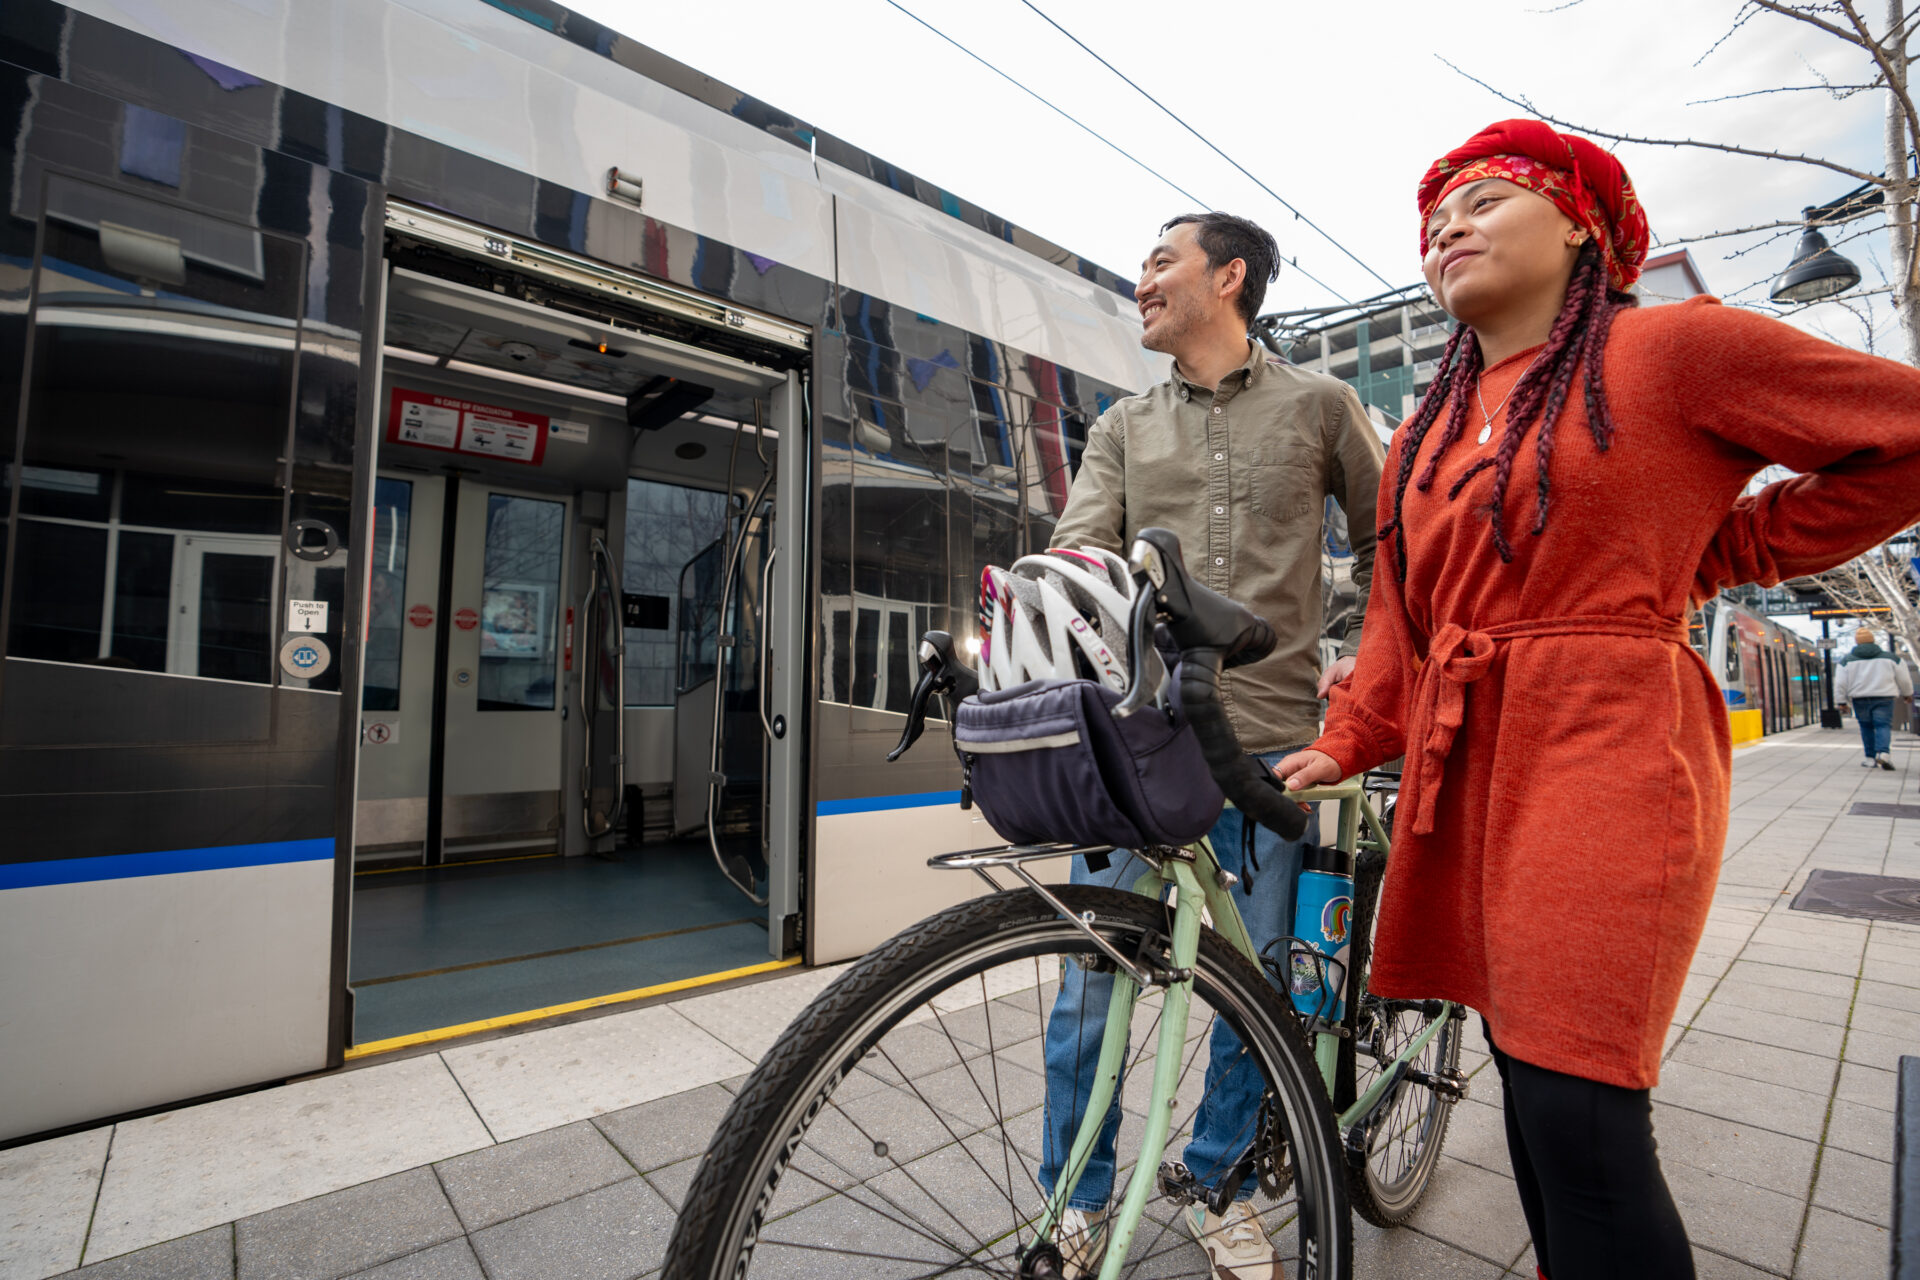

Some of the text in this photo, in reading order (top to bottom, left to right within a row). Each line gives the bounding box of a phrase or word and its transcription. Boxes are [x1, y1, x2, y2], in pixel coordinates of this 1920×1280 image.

[433, 397, 513, 418] IN CASE OF EVACUATION
